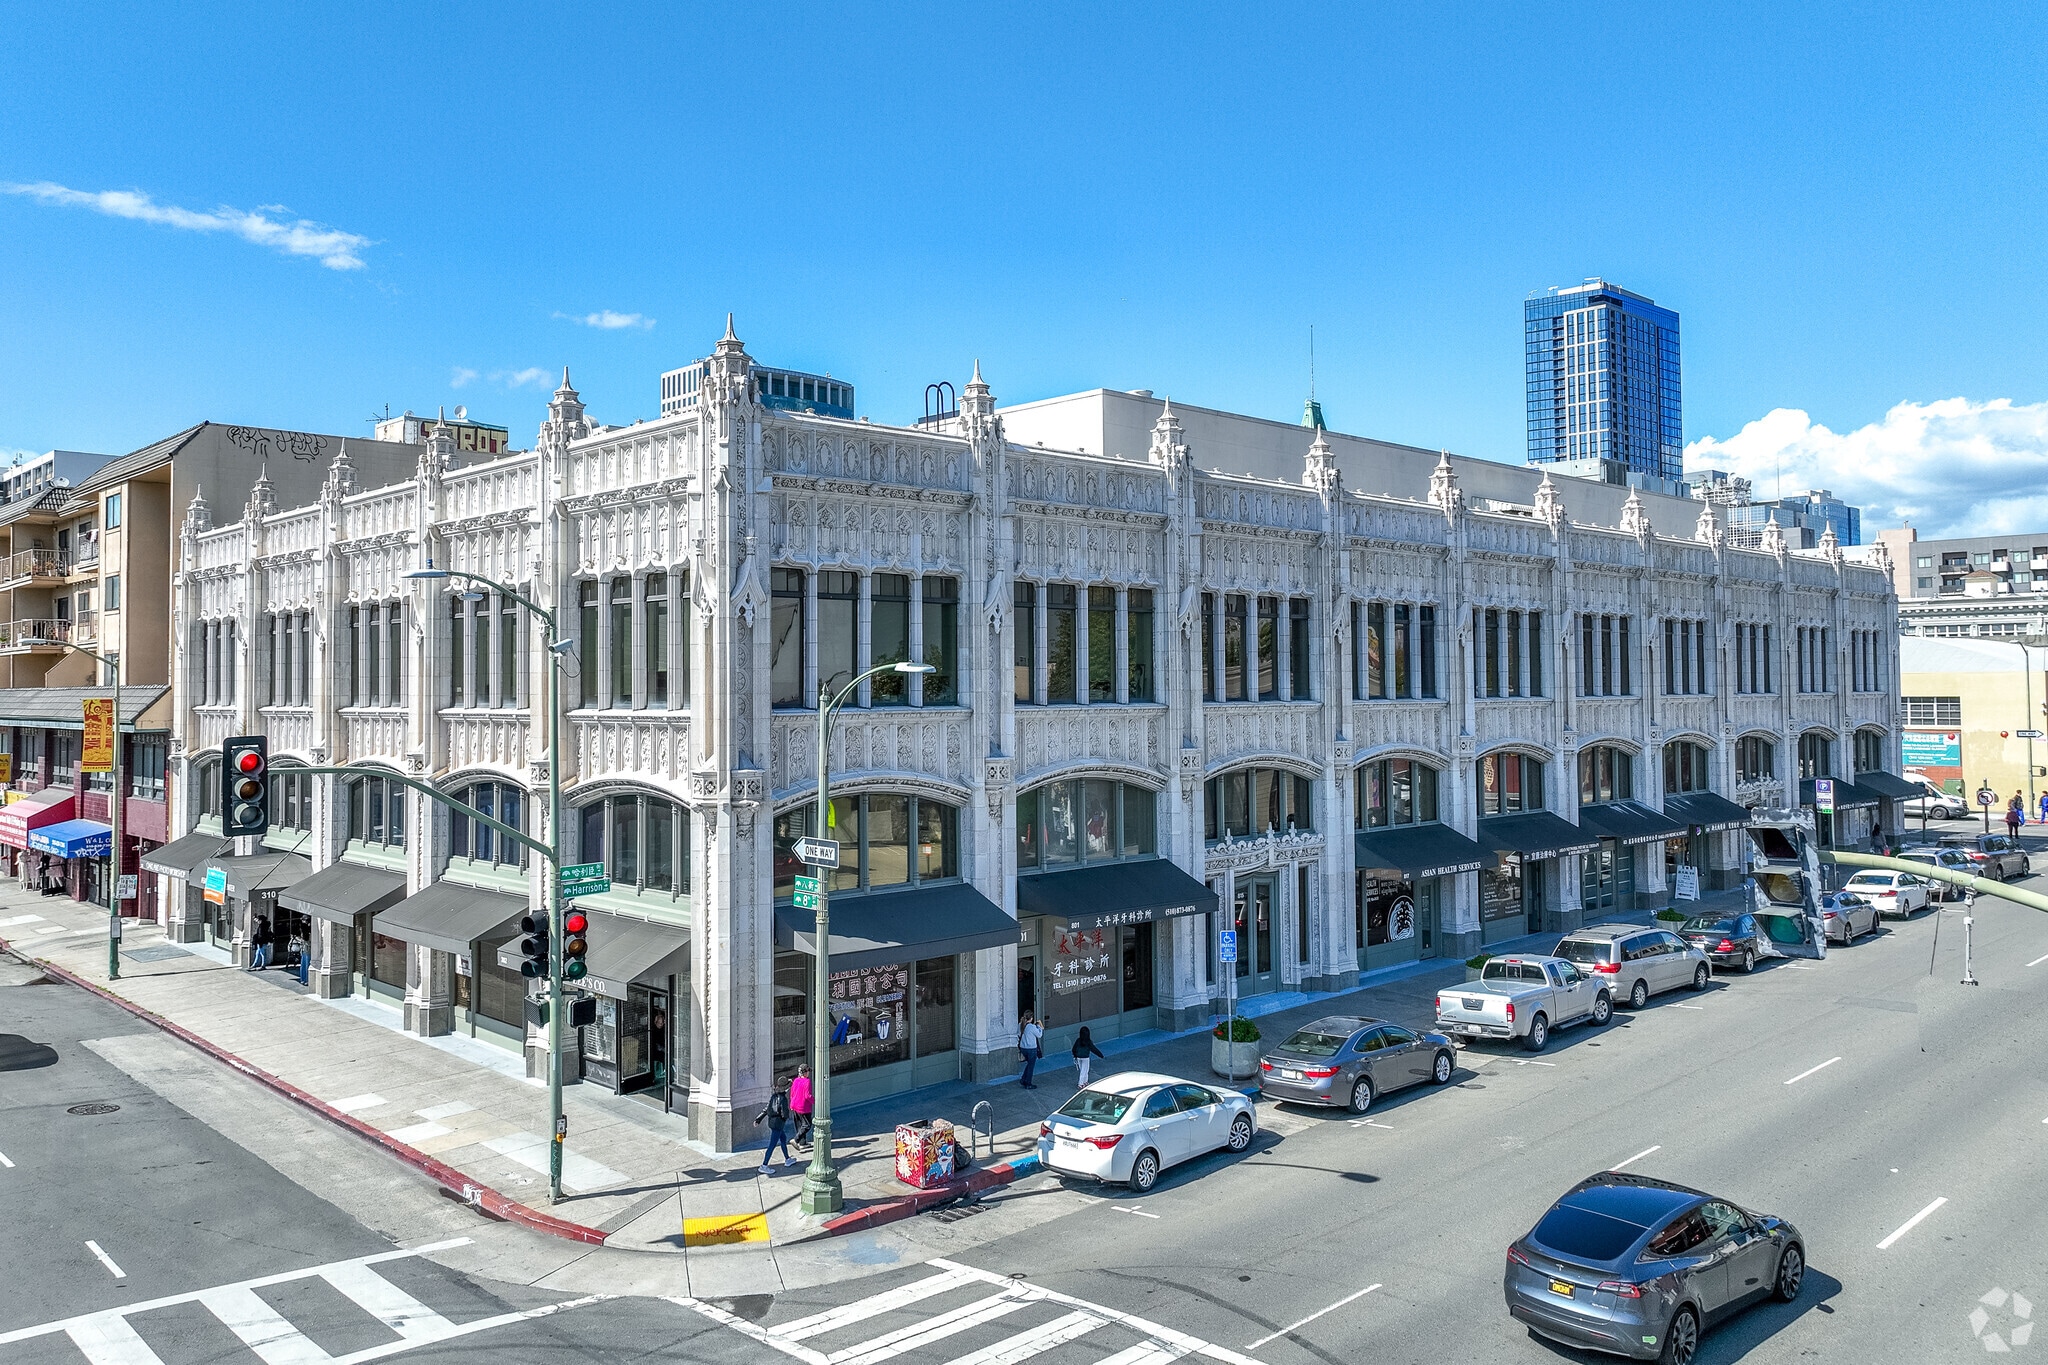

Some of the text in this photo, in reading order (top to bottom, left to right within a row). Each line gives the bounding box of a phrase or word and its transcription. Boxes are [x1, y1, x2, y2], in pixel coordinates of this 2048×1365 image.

[805, 845, 834, 858] ONE WAY
[1421, 868, 1437, 878] ASIAN
[1438, 865, 1458, 875] HEALTH
[1458, 861, 1482, 872] SERVICES
[261, 891, 276, 899] 310
[572, 883, 603, 895] Harrison
[1071, 921, 1080, 929] 801
[1095, 909, 1153, 928] 太平洋牙科診所
[1058, 928, 1104, 955] 太平洋
[1051, 953, 1110, 977] 牙科診所
[593, 979, 607, 993] CO.
[1080, 974, 1107, 985] 873-0876
